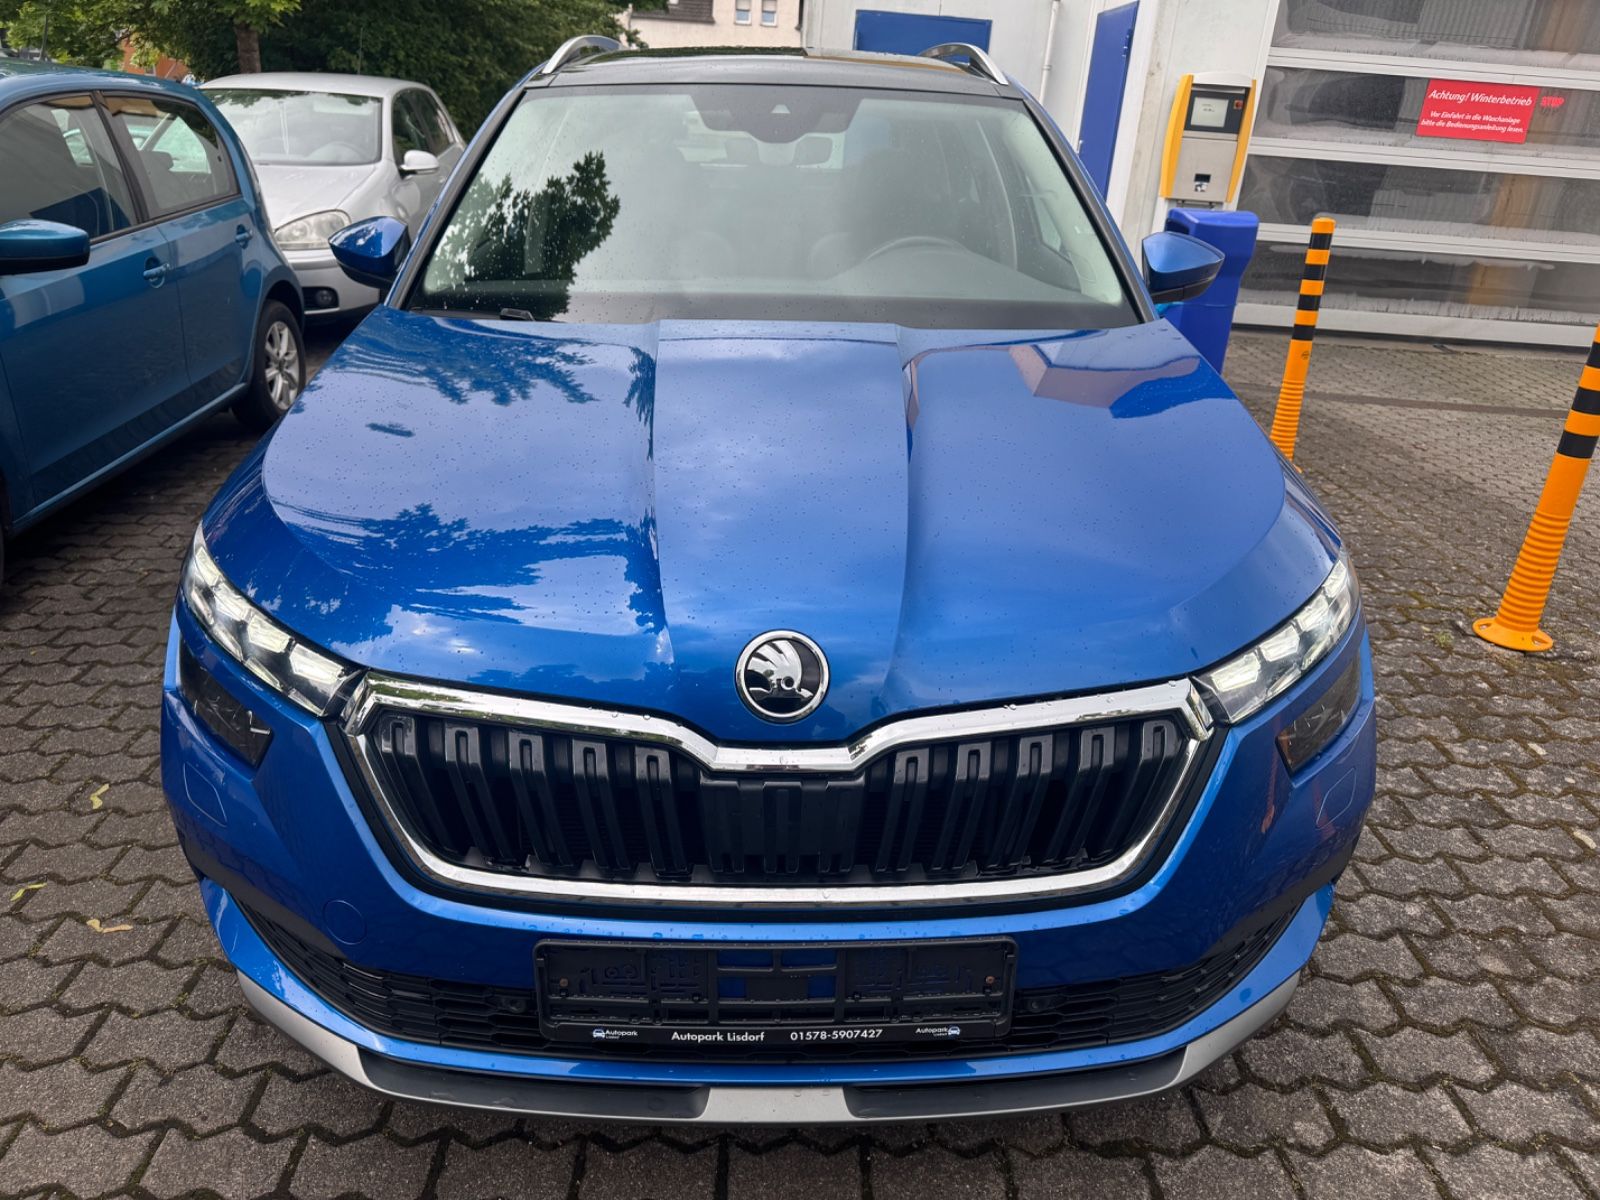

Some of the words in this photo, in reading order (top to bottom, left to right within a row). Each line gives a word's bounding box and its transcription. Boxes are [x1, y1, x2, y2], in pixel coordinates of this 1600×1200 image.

[1428, 90, 1470, 104] Achtung!
[1470, 92, 1533, 106] Winterbetrieb
[1472, 113, 1481, 121] die
[1436, 119, 1446, 127] die
[605, 1029, 638, 1037] Autopark
[671, 1031, 724, 1043] Autopark
[727, 1031, 765, 1042] Lisdorf
[790, 1029, 883, 1041] 01578-5907427
